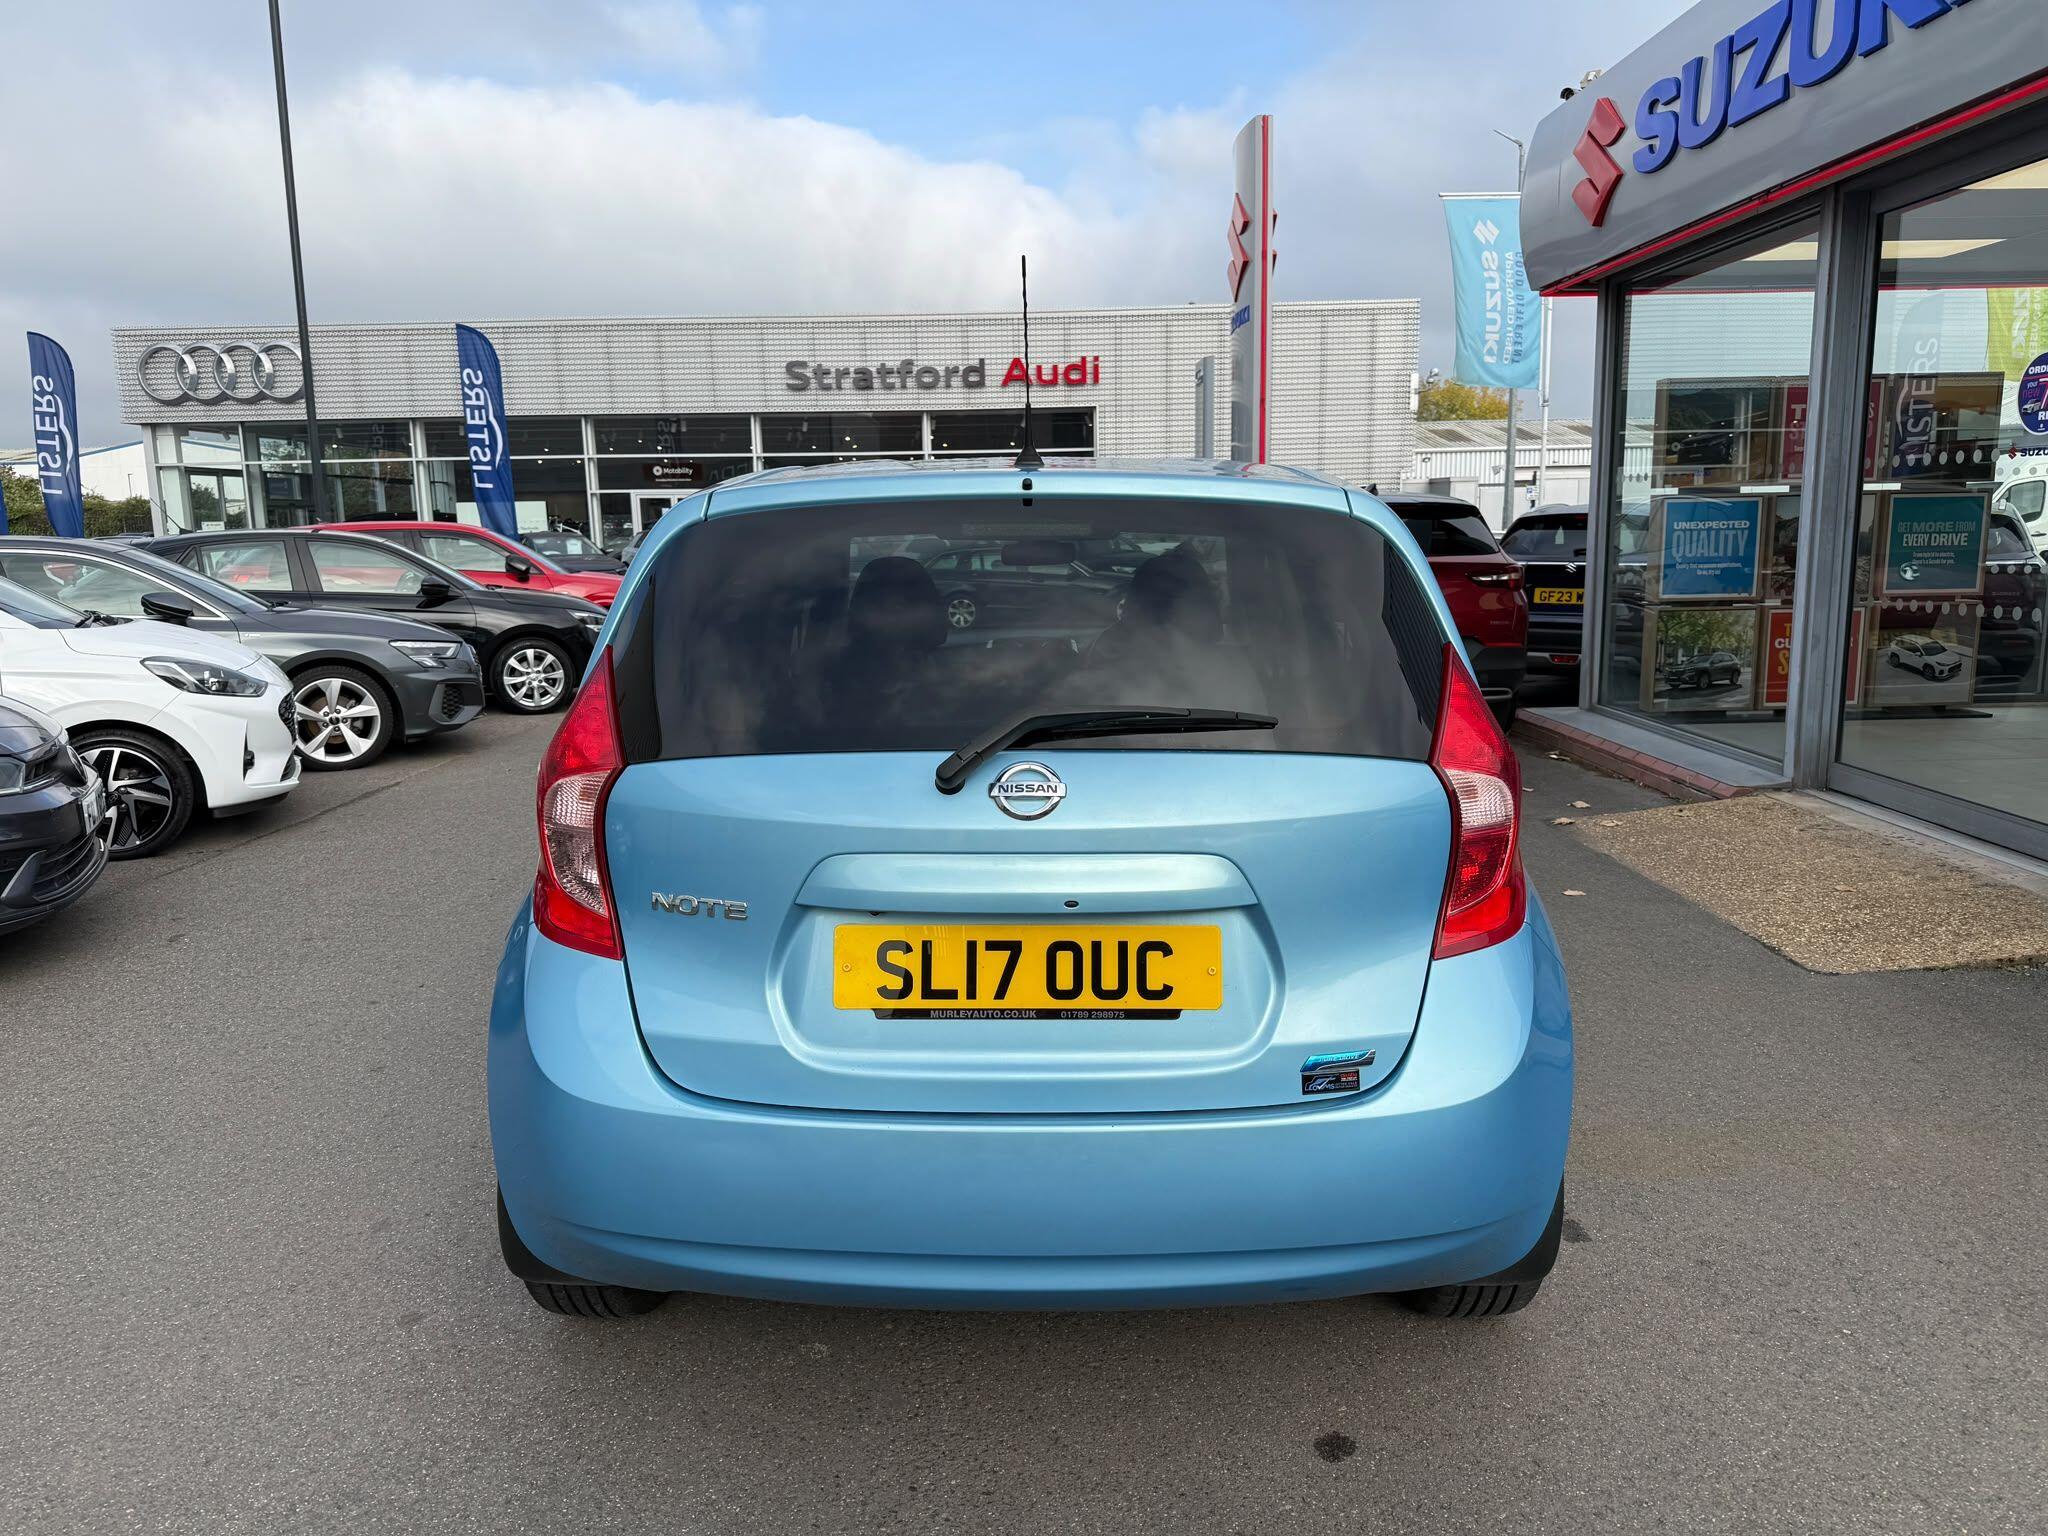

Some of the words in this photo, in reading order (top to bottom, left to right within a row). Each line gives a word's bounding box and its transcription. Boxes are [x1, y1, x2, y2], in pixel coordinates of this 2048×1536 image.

[1632, 0, 1968, 174] SUZU
[785, 357, 987, 392] Stratford
[1000, 355, 1101, 388] Audi
[2028, 364, 2048, 375] ORD
[1673, 520, 1750, 530] UNEXPECTED
[1912, 521, 1955, 533] MORE
[1671, 529, 1750, 562] QUALITY
[1902, 533, 1930, 547] EVERY
[1930, 532, 1969, 547] DRIVE
[1539, 590, 1573, 603] GF23
[998, 783, 1058, 794] NISSAN
[651, 891, 749, 920] NOTE
[876, 939, 1023, 1001] SL17
[1045, 939, 1175, 1001] OUC
[929, 1009, 1038, 1019] MURLEYAUTO.CO.UK
[1060, 1011, 1090, 1019] 01789
[1091, 1011, 1126, 1019] 298975
